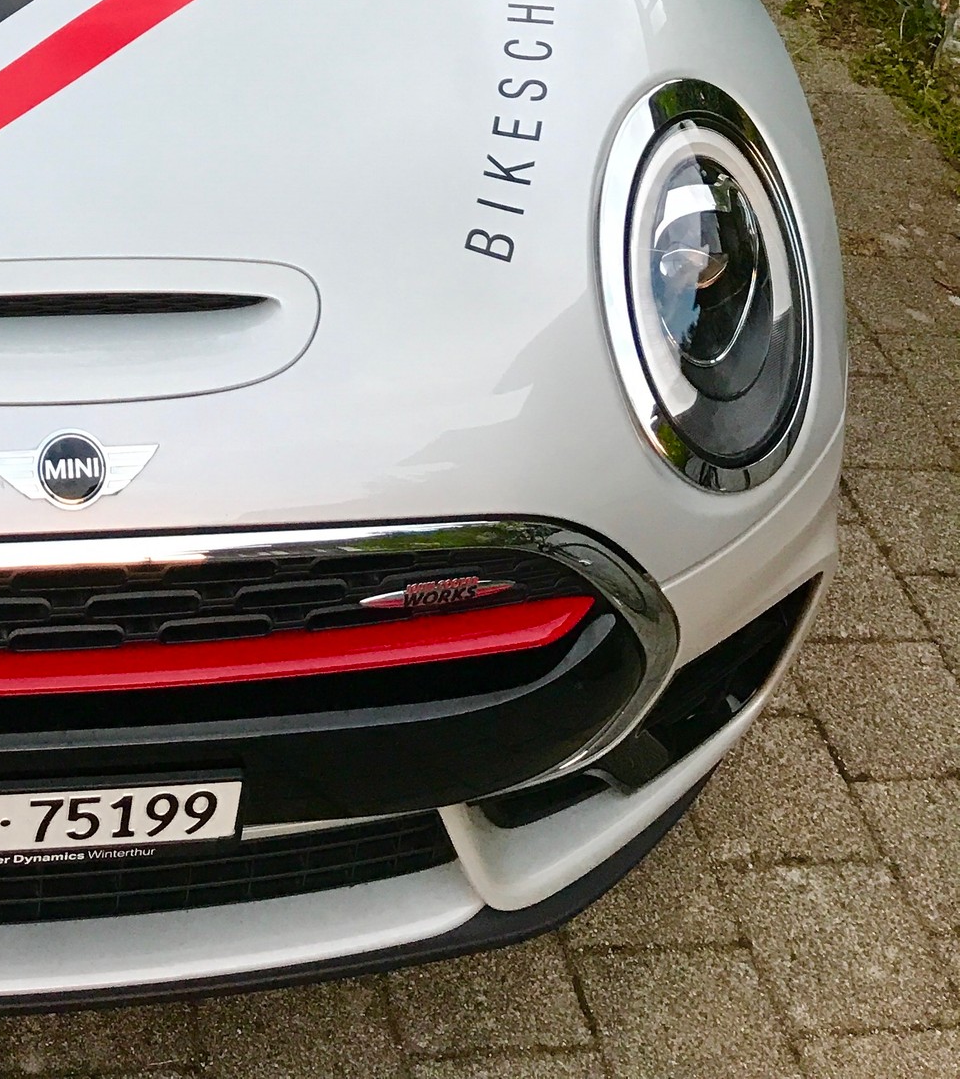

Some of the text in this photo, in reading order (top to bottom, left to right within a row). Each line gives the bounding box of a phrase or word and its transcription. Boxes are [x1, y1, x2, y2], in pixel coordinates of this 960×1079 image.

[44, 457, 100, 481] MINI
[404, 584, 478, 607] WORKS
[30, 791, 218, 843] 75199
[13, 851, 85, 865] Dynamics
[87, 847, 157, 860] Winterthur
